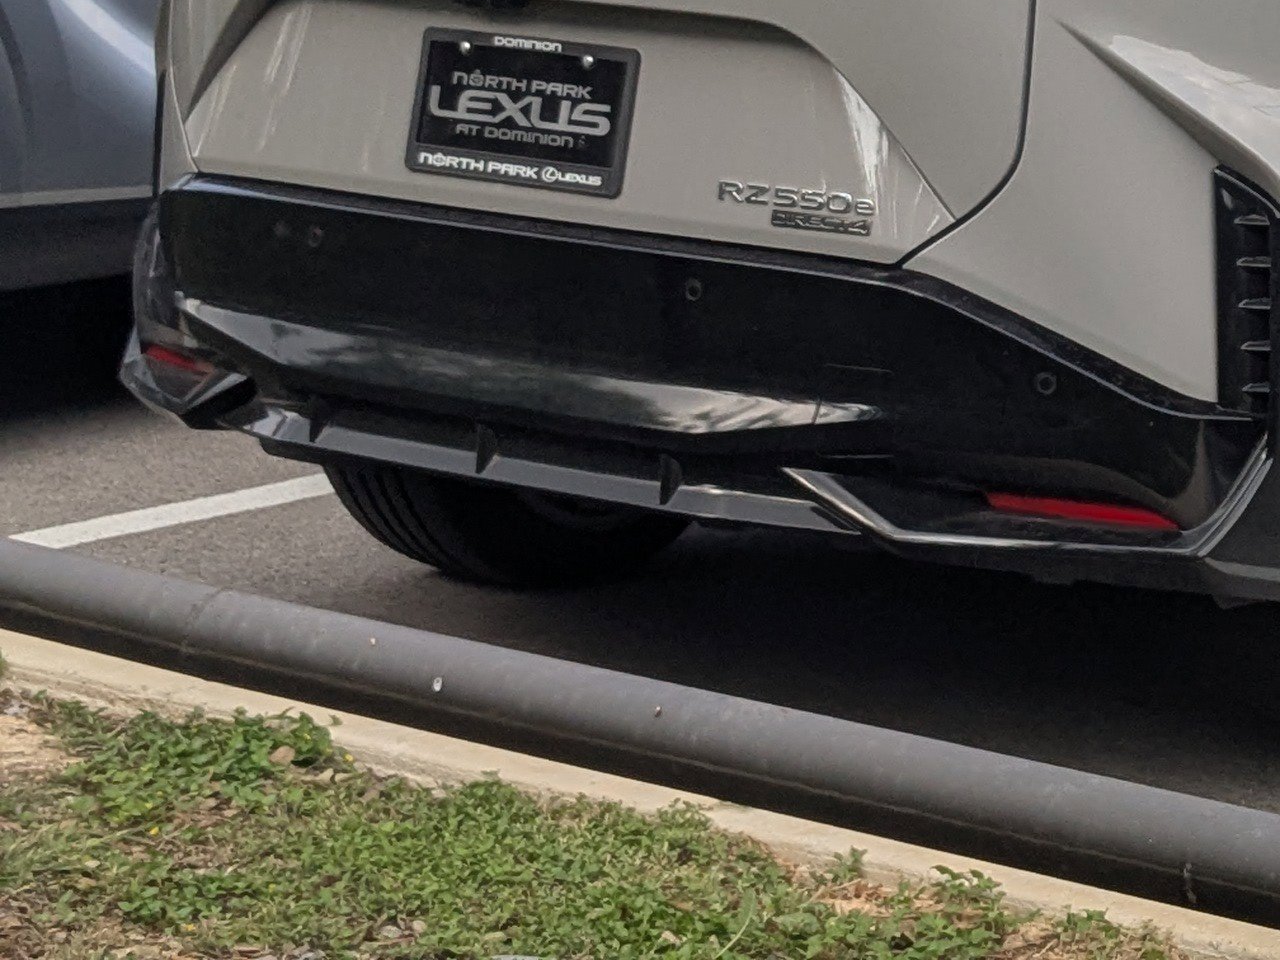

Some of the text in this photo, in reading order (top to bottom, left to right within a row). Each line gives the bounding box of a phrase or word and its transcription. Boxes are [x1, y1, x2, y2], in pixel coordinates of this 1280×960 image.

[531, 79, 593, 99] PARK
[429, 84, 611, 136] LEXUS
[487, 161, 538, 179] PARK
